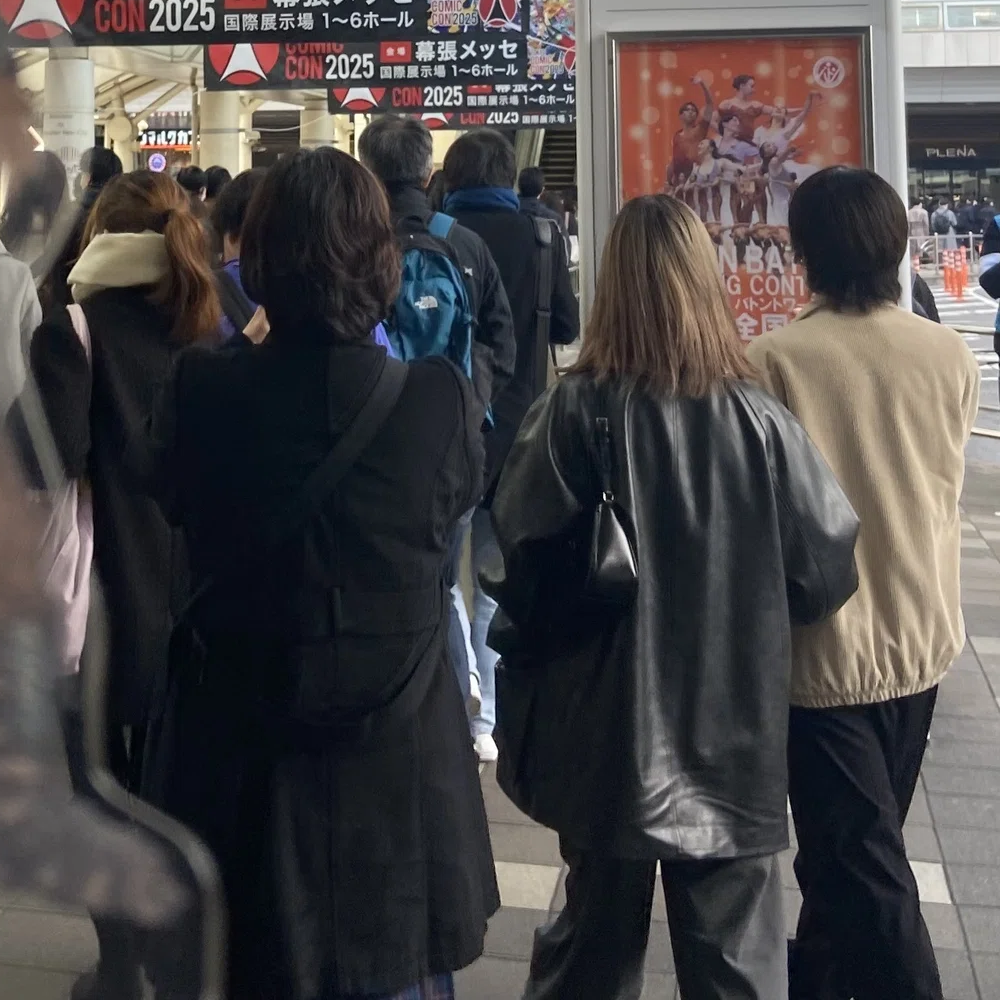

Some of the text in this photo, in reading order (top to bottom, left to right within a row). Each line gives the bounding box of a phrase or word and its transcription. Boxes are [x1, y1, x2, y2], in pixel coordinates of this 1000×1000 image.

[432, 0, 462, 12] COMIC
[224, 12, 314, 31] 国際展示場
[432, 12, 477, 25] CON 2025
[415, 40, 518, 62] 幕張メッセ
[285, 53, 374, 80] CON 2025
[380, 66, 446, 79] 国際展示場
[392, 86, 463, 107] CON 2025
[926, 145, 976, 157] PLENA
